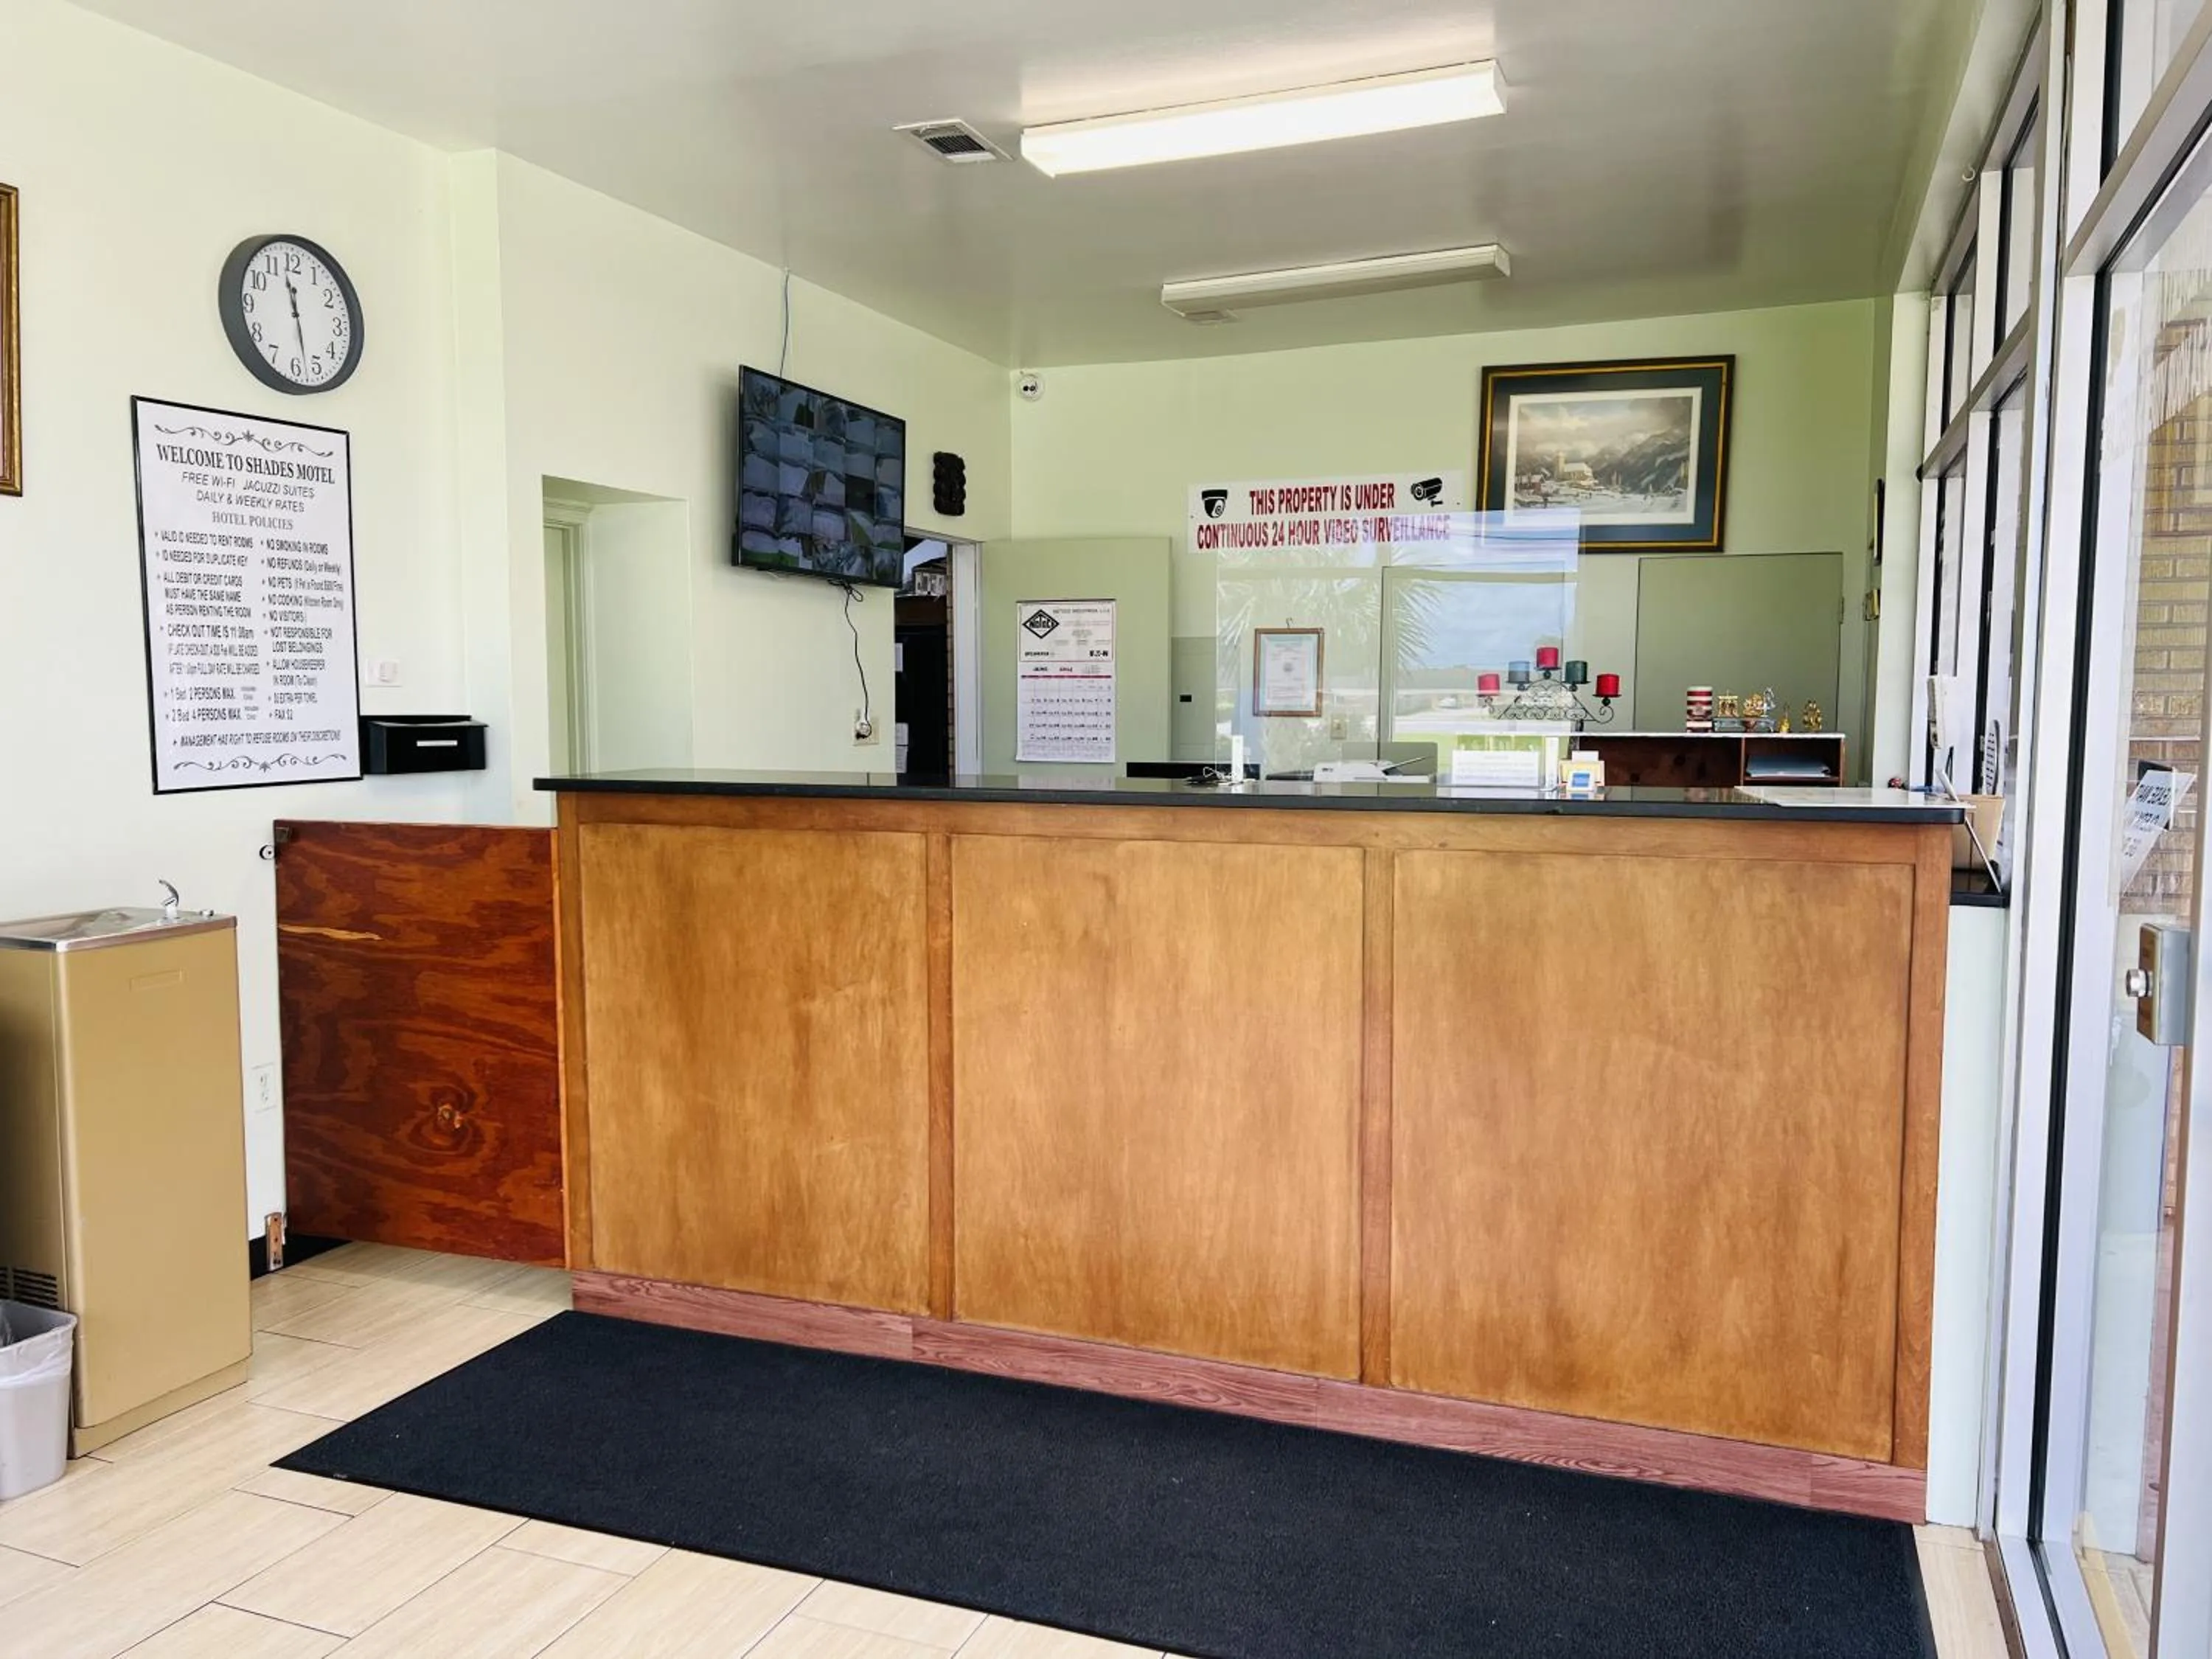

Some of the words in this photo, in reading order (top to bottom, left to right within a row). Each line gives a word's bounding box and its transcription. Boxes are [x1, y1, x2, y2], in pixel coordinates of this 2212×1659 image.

[265, 254, 279, 276] 11
[284, 252, 302, 275] 12
[249, 269, 266, 291] 10
[310, 266, 319, 286] 1
[243, 293, 254, 313] 9
[322, 288, 334, 309] 2
[251, 321, 262, 343] 8
[333, 316, 343, 337] 3
[268, 344, 279, 364] 7
[325, 341, 335, 359] 4
[290, 357, 302, 377] 6
[311, 355, 322, 375] 5
[156, 443, 223, 470] WELCOME
[226, 453, 243, 471] TO
[246, 456, 294, 479] SHADES
[296, 463, 335, 484] MOTEL
[182, 471, 209, 486] FREE
[243, 479, 281, 495] JACUZZI
[283, 484, 315, 498] SUITES
[196, 490, 224, 505] DAILY
[226, 493, 232, 505] &
[235, 495, 273, 509] WEEKLY
[275, 499, 305, 512] RATES
[1249, 487, 1275, 515] THIS
[1278, 484, 1338, 514] PROPERTY
[1339, 484, 1351, 510] IS
[1355, 482, 1395, 509] UNDER
[212, 512, 247, 526] HOTEL
[249, 515, 293, 530] POLICIES
[1197, 518, 1269, 549] CONTINUOUS
[1272, 521, 1285, 546] 24
[1288, 519, 1320, 546] HOUR
[1324, 518, 1357, 545] VIDEO
[1362, 515, 1450, 543] SURVEILLANCE
[167, 623, 191, 637] CHECK
